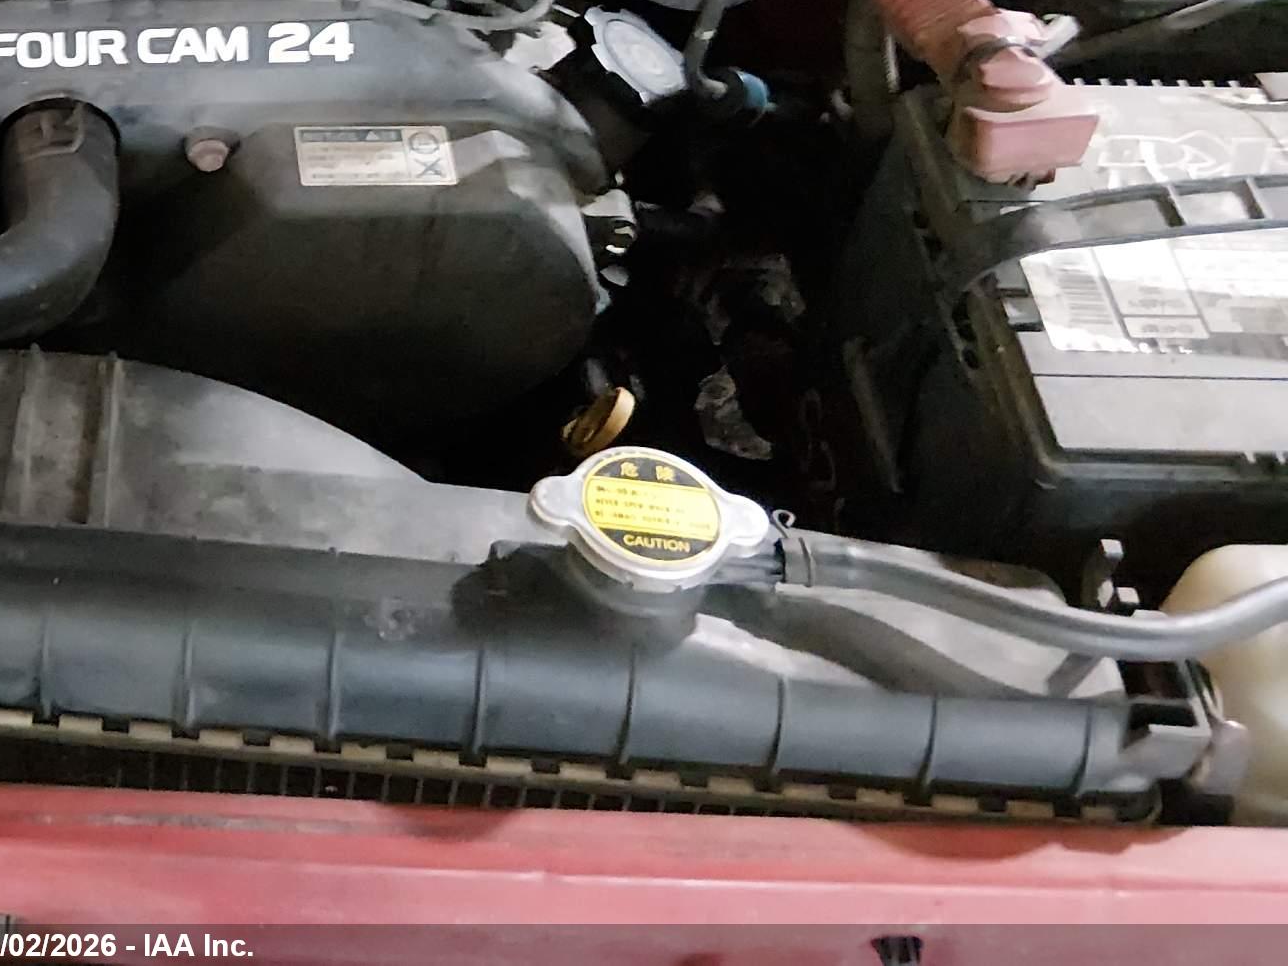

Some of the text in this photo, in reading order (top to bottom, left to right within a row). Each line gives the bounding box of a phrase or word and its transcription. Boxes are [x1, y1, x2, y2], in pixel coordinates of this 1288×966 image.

[137, 25, 250, 64] CAM
[267, 21, 355, 64] 24
[624, 535, 690, 552] CAUTION
